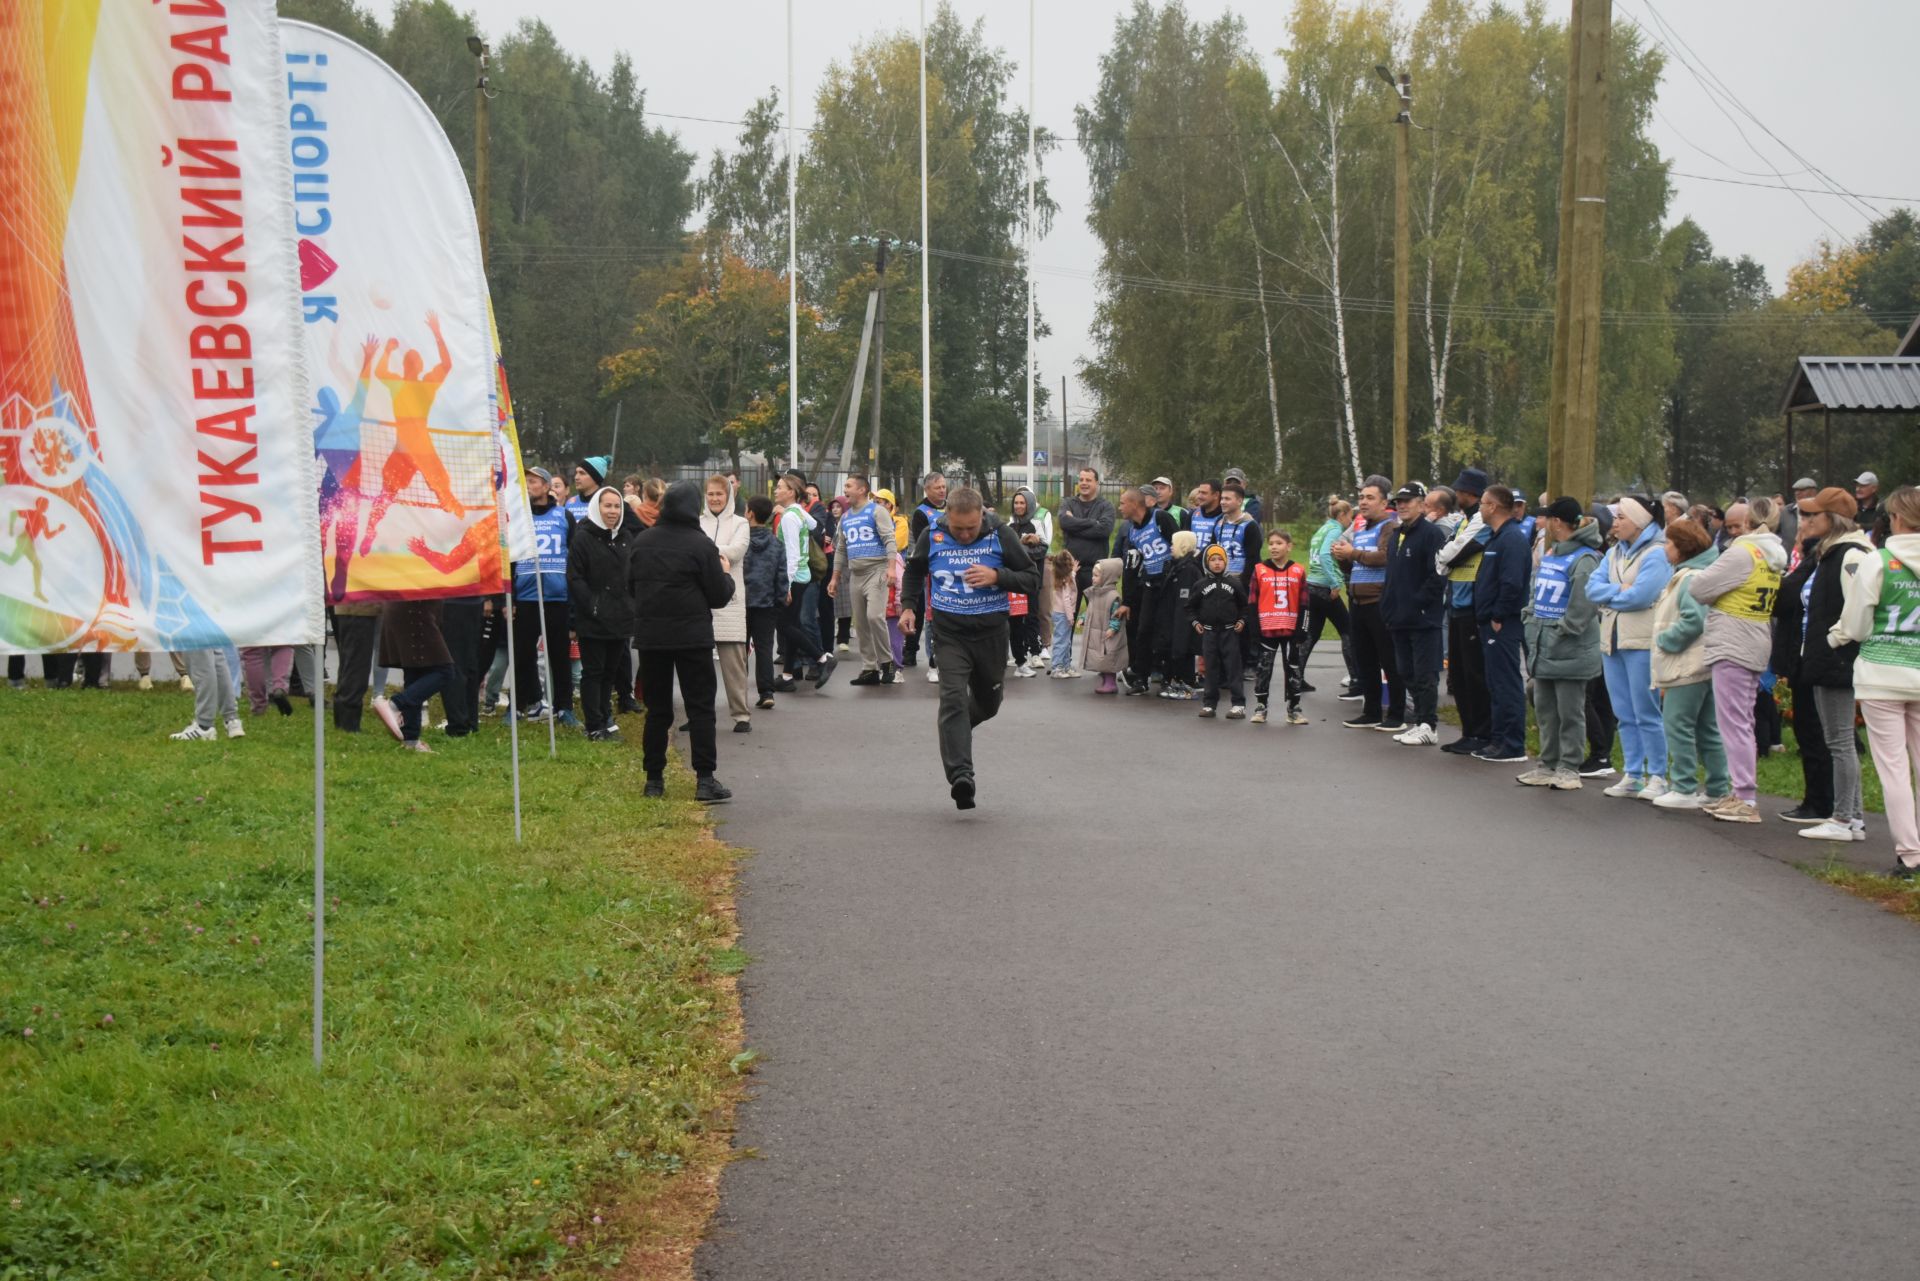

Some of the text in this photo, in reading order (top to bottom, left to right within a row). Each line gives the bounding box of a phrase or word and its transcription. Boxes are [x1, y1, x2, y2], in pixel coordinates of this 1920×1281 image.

[286, 53, 339, 324] Я СПОРТ!
[161, 138, 264, 565] ТУКАЕВСКИЙ
[948, 555, 980, 565] РАЙОН
[1138, 537, 1168, 559] 06
[1273, 589, 1289, 609] 3
[1535, 577, 1567, 604] 77
